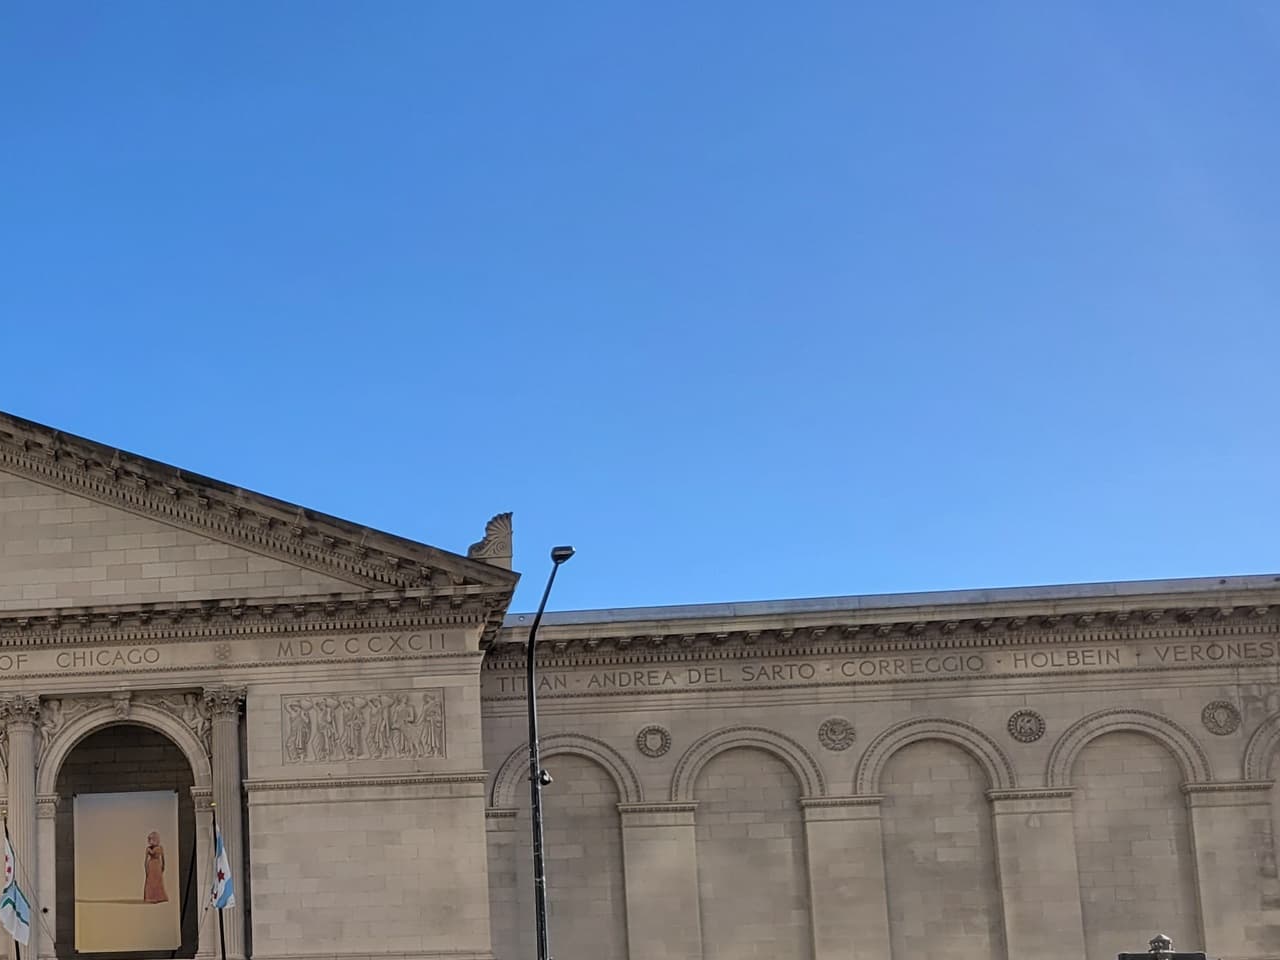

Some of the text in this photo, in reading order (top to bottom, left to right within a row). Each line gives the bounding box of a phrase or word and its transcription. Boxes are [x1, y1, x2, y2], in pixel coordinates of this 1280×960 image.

[56, 647, 160, 669] CHICAGO
[277, 633, 446, 657] MDCCCXCII
[496, 641, 1280, 693] TITAN ANDREA DEL SARTO CORREGGIO HOLBEIN VERONES
